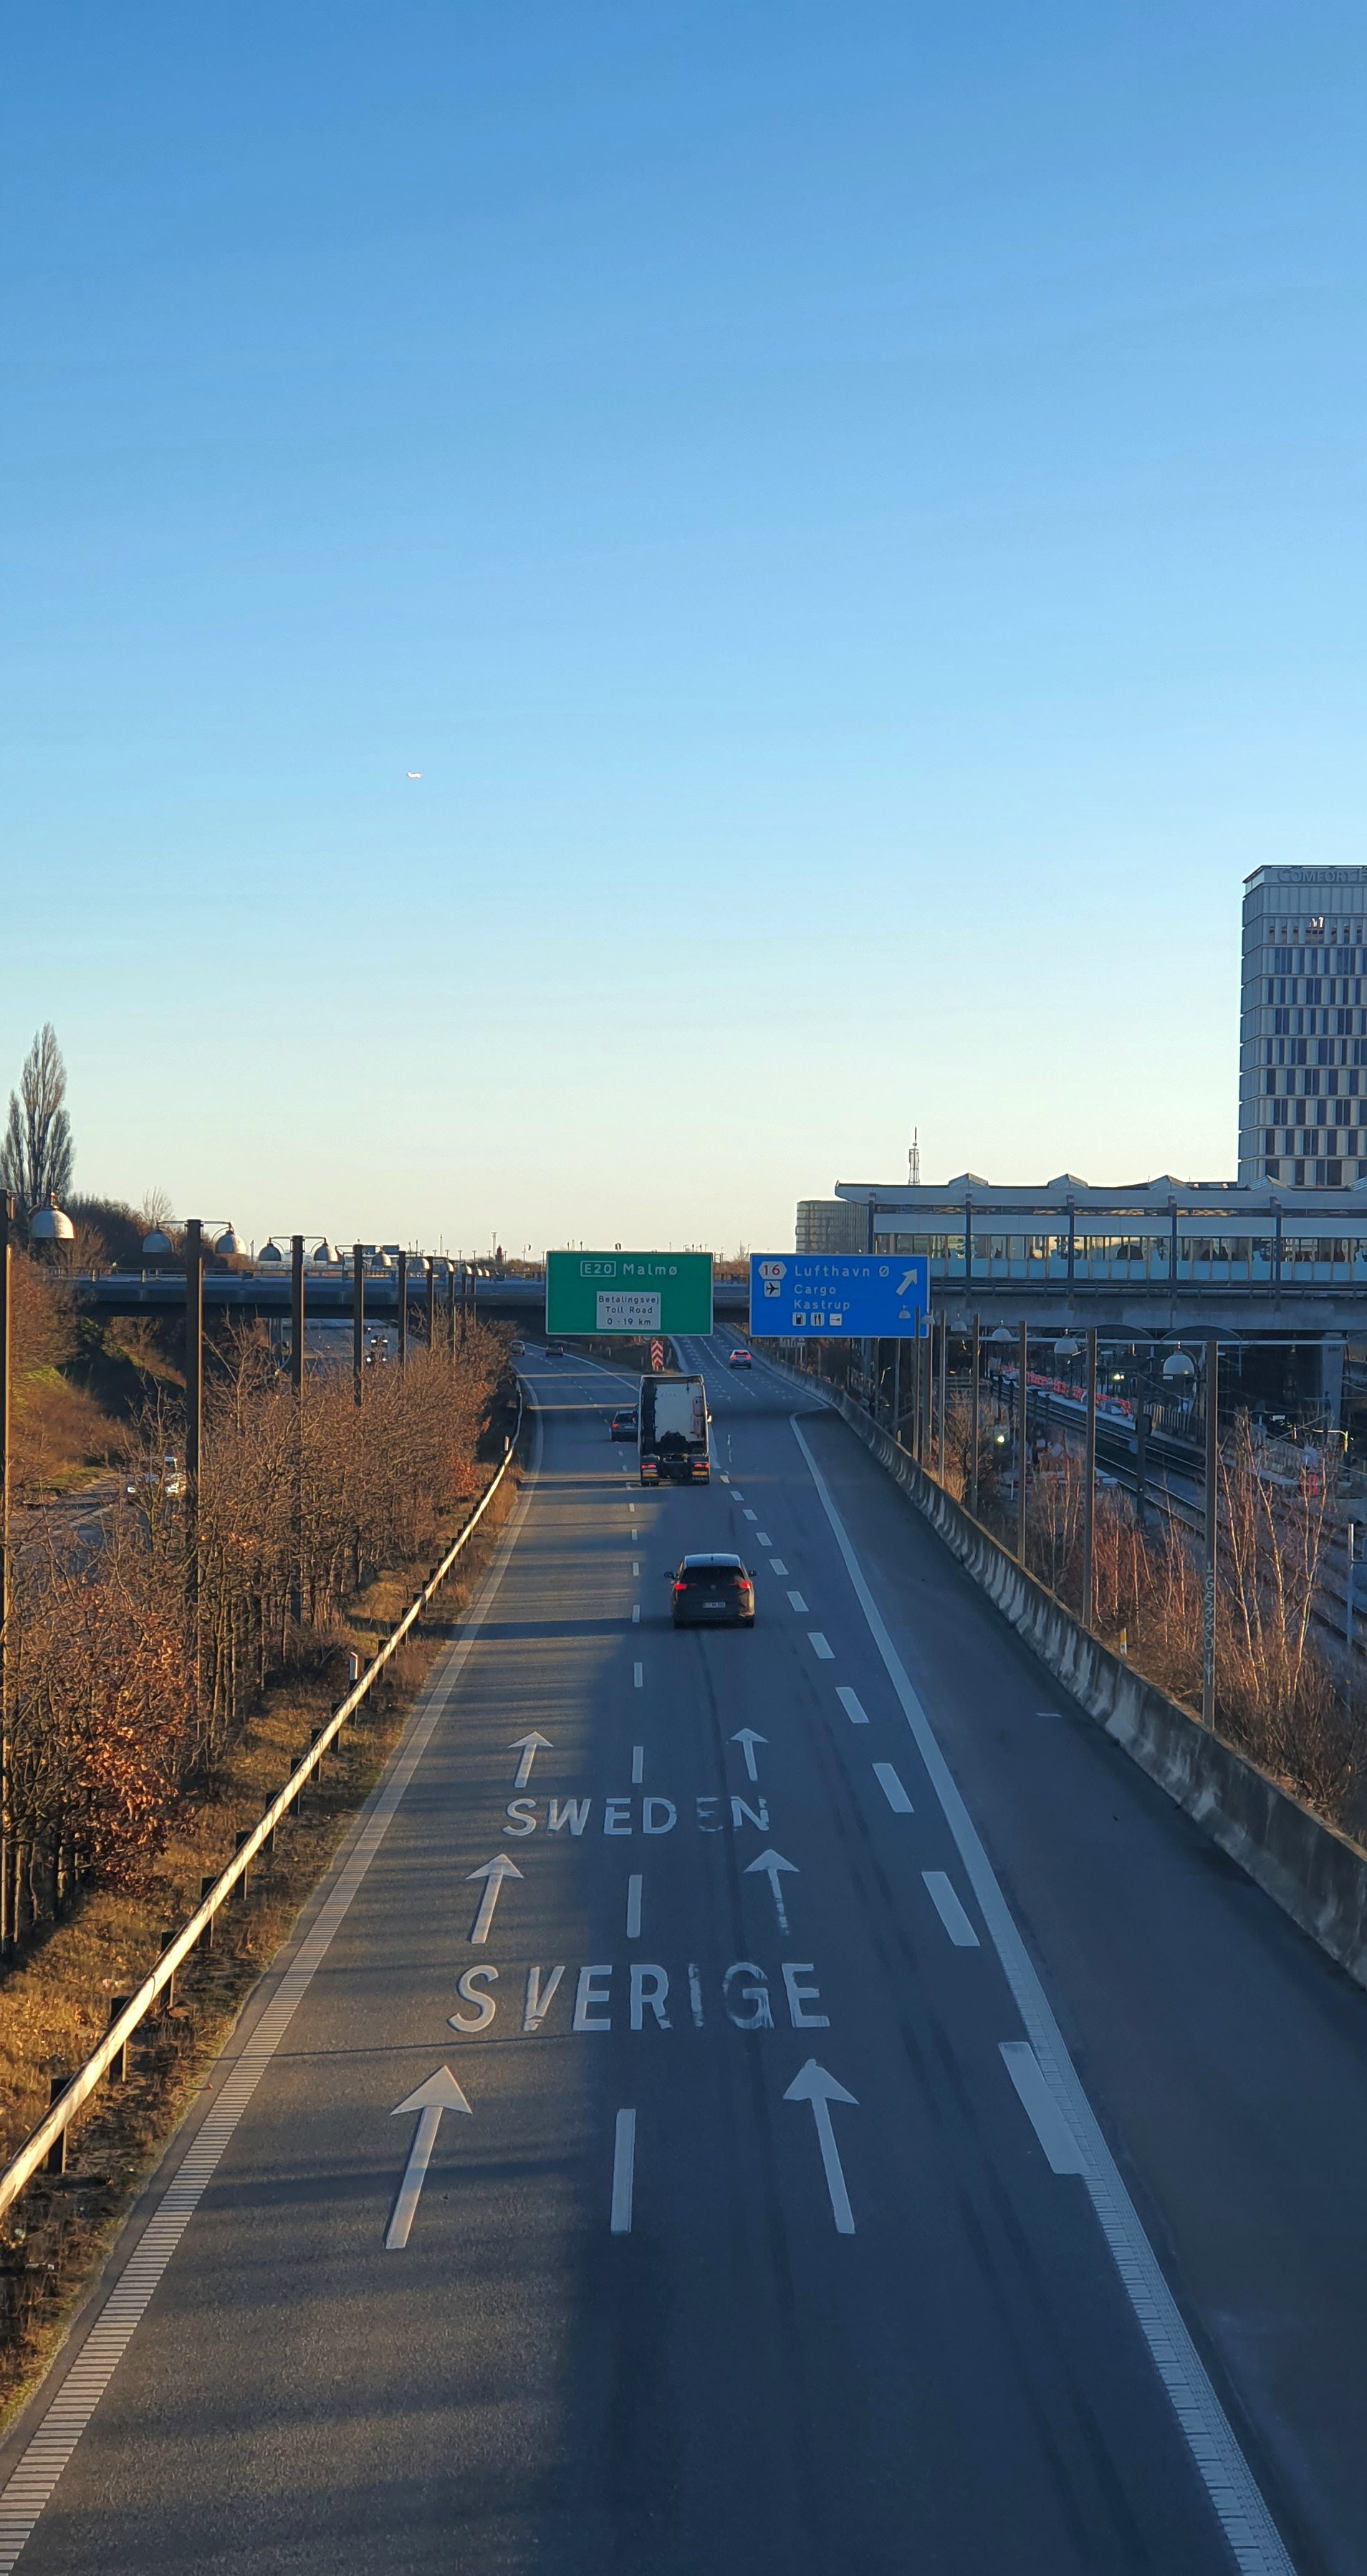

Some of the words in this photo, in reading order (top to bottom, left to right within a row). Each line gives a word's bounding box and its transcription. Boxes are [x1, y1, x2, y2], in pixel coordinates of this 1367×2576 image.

[585, 1264, 612, 1274] E20
[623, 1263, 677, 1275] Malmø
[762, 1264, 781, 1276] 16
[795, 1264, 870, 1277] Lufthavn
[878, 1265, 890, 1277] Ø
[794, 1284, 837, 1297] Cargo
[598, 1295, 659, 1304] Betalingsvej
[794, 1299, 850, 1312] Kastrup
[502, 1795, 770, 1836] SWEDEN
[446, 1961, 830, 2033] SVERIGE
